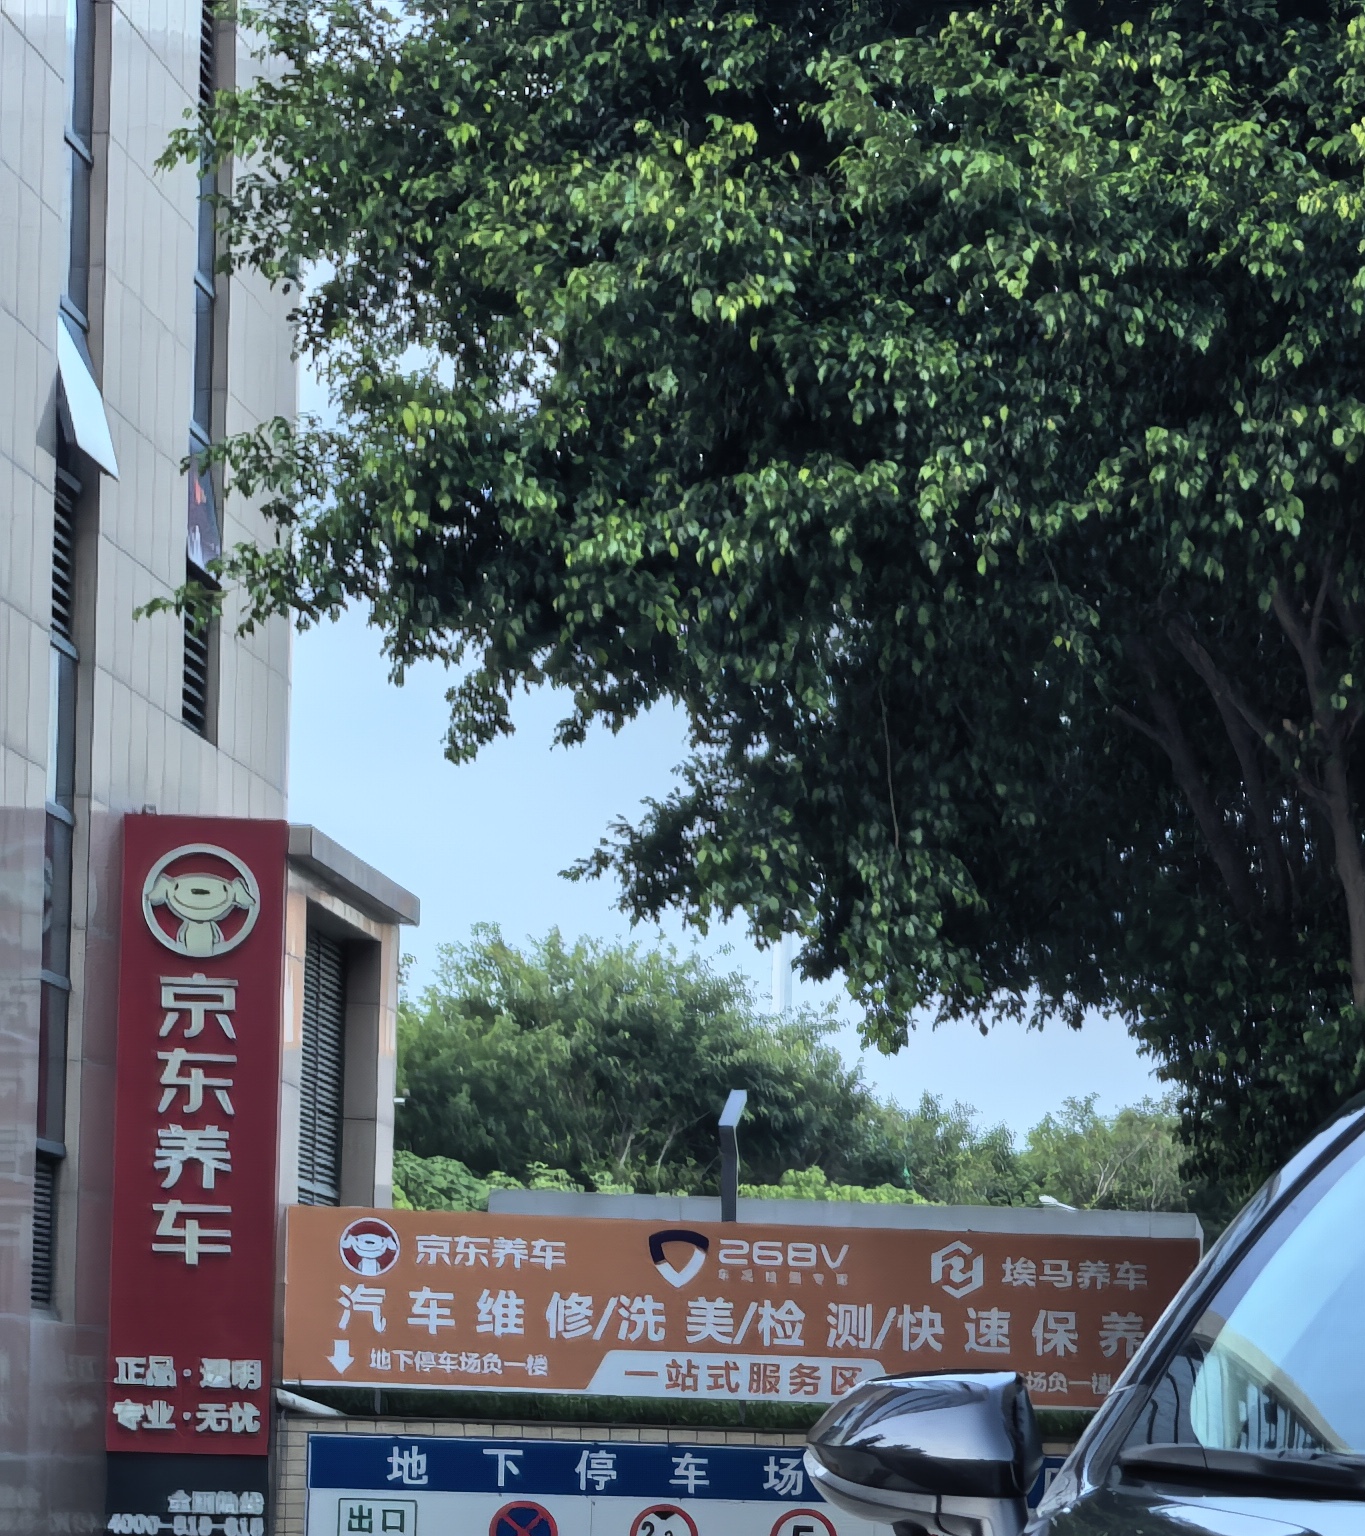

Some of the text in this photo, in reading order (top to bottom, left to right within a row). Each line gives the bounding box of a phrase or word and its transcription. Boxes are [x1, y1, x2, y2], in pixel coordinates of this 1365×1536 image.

[151, 972, 238, 1267] 京东养车
[415, 1234, 566, 1270] 京东养车
[717, 1238, 850, 1270] 268V
[1002, 1256, 1148, 1290] 埃马养车
[337, 1283, 1146, 1359] 汽车维修/洗美/检测/快速保养
[113, 1355, 262, 1390] 正品·透明
[369, 1347, 548, 1377] 地下停车场负一楼
[624, 1358, 863, 1396] 一站式服务区
[1022, 1370, 1112, 1394] 场负一楼
[112, 1398, 261, 1433] 专业·无忧
[347, 1504, 406, 1534] 出口
